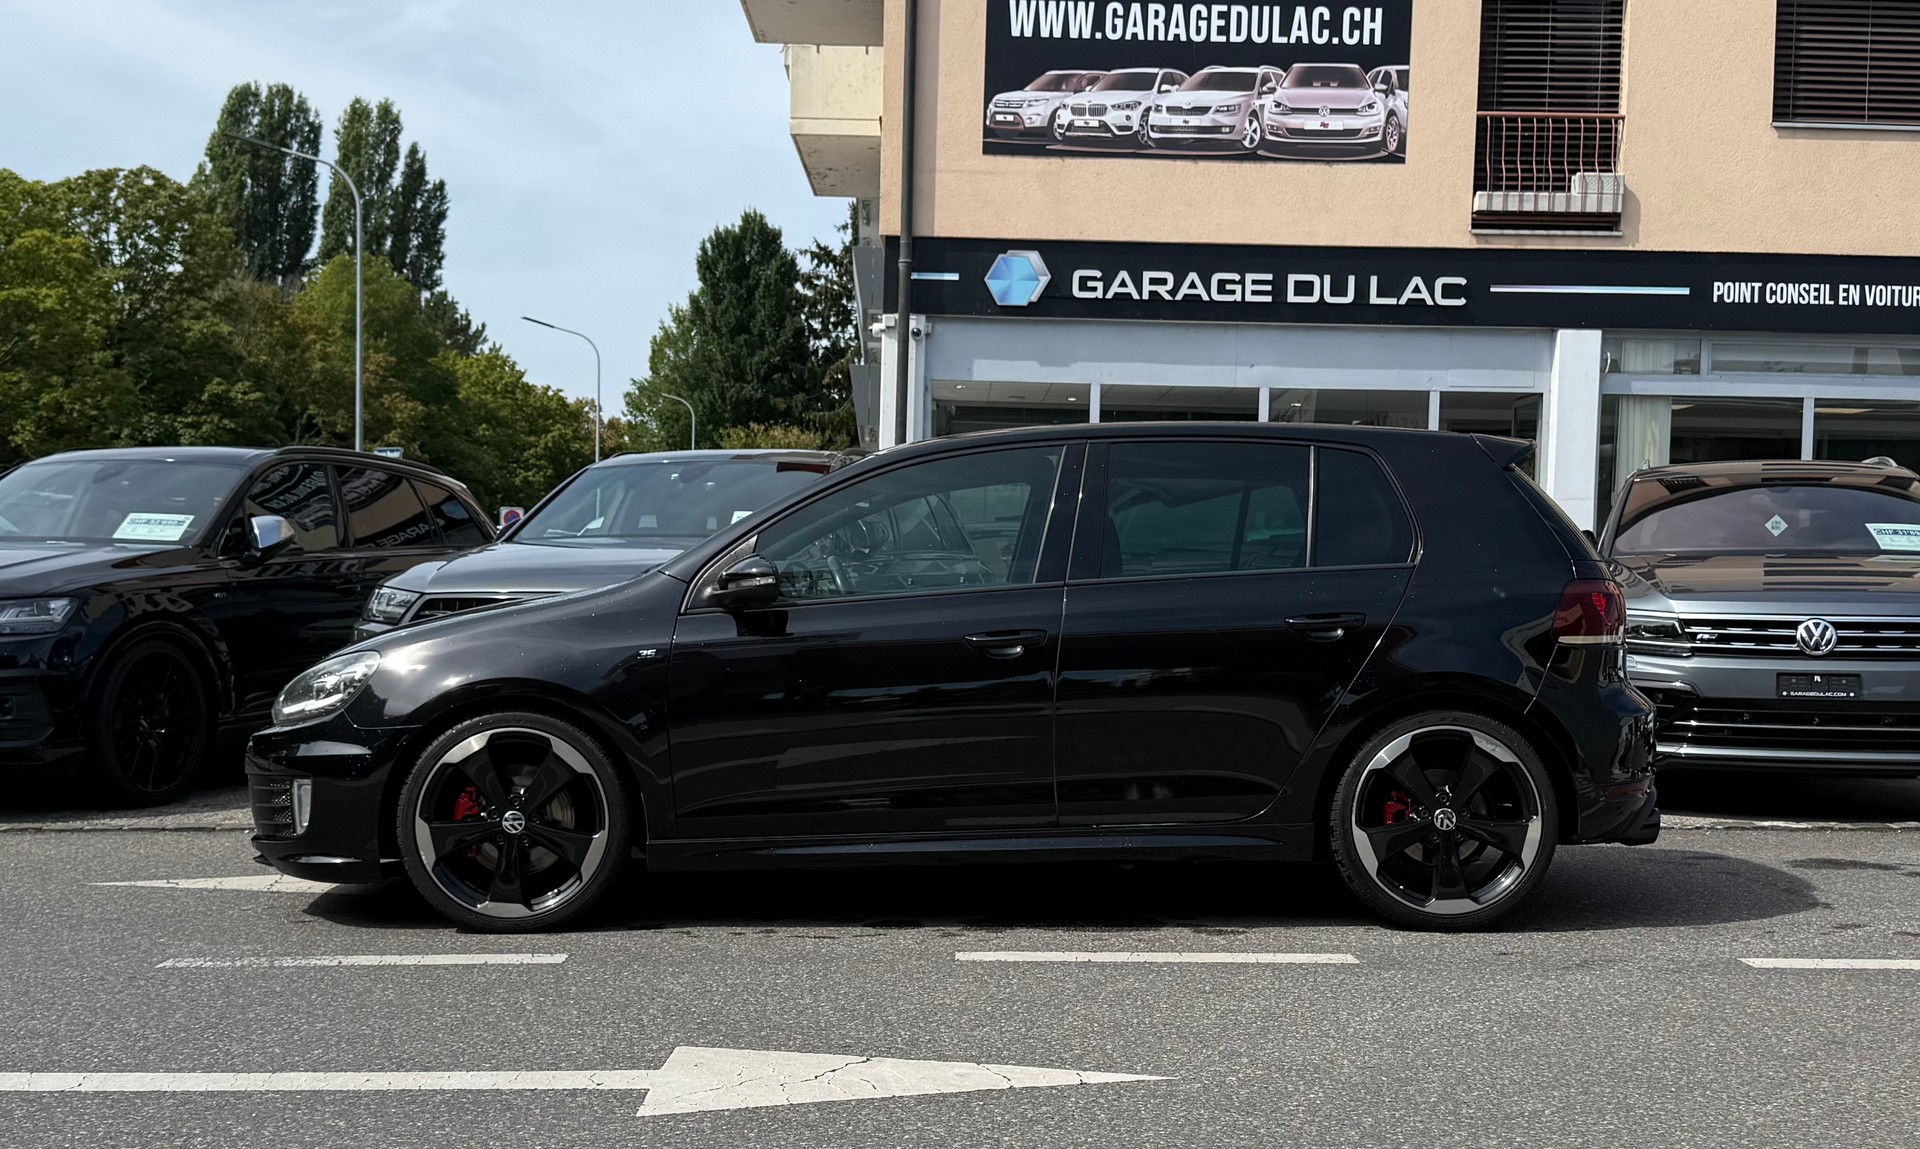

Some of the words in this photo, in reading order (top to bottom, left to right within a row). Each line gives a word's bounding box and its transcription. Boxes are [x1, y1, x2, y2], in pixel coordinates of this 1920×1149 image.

[1008, 0, 1383, 47] WWW.GARAGEDULAC.CH
[1072, 269, 1274, 302] GARAGE
[1287, 273, 1356, 304] DU
[1369, 275, 1468, 306] LAC
[1713, 281, 1762, 303] POINT
[1765, 282, 1834, 305] CONSEIL
[1839, 284, 1860, 306] EN
